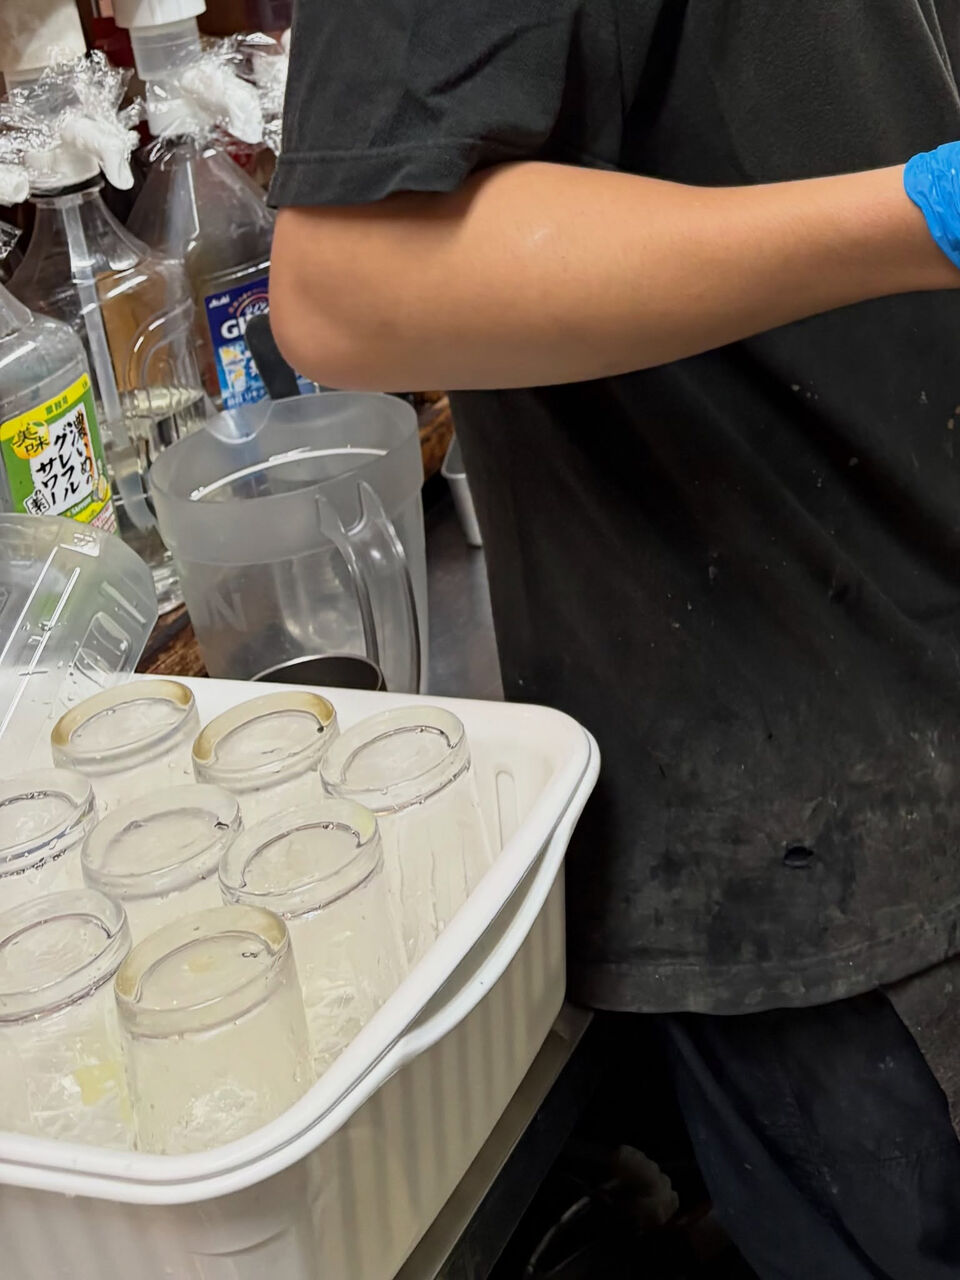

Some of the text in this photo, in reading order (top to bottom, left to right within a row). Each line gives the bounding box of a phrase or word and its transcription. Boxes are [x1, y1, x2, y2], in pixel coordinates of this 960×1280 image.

[12, 423, 49, 454] 美味
[54, 422, 81, 503] グレフル
[36, 456, 58, 505] サワー
